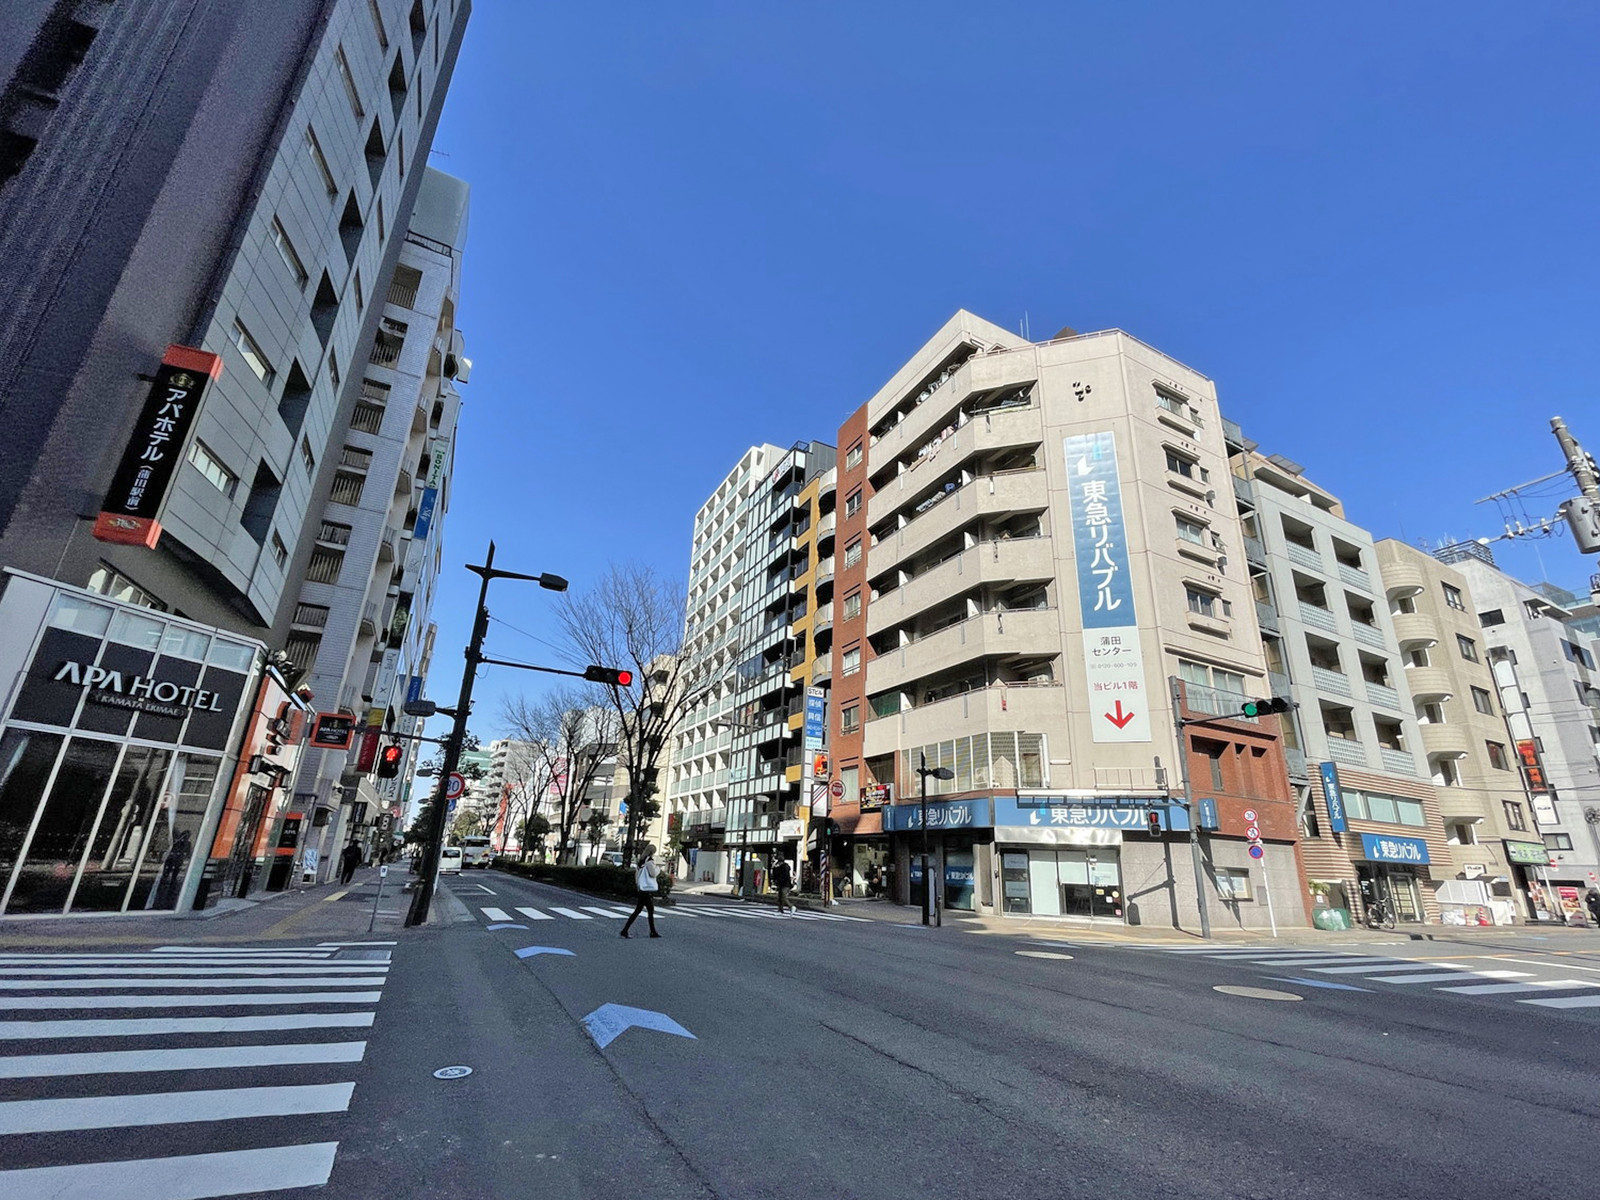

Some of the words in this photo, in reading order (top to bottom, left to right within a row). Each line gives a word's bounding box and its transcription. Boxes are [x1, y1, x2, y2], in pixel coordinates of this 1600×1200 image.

[140, 388, 188, 462] アパホテル
[1080, 479, 1122, 612] 東急リバブル
[1091, 646, 1132, 657] センター
[1100, 635, 1121, 646] 蒲田
[53, 660, 123, 694] APA
[130, 674, 224, 713] HOTEL
[1093, 680, 1139, 691] 当ビル1階
[1327, 783, 1342, 820] 東急リバブル
[1050, 803, 1147, 826] 東急リバブル
[1379, 839, 1421, 862] 東急リバブル
